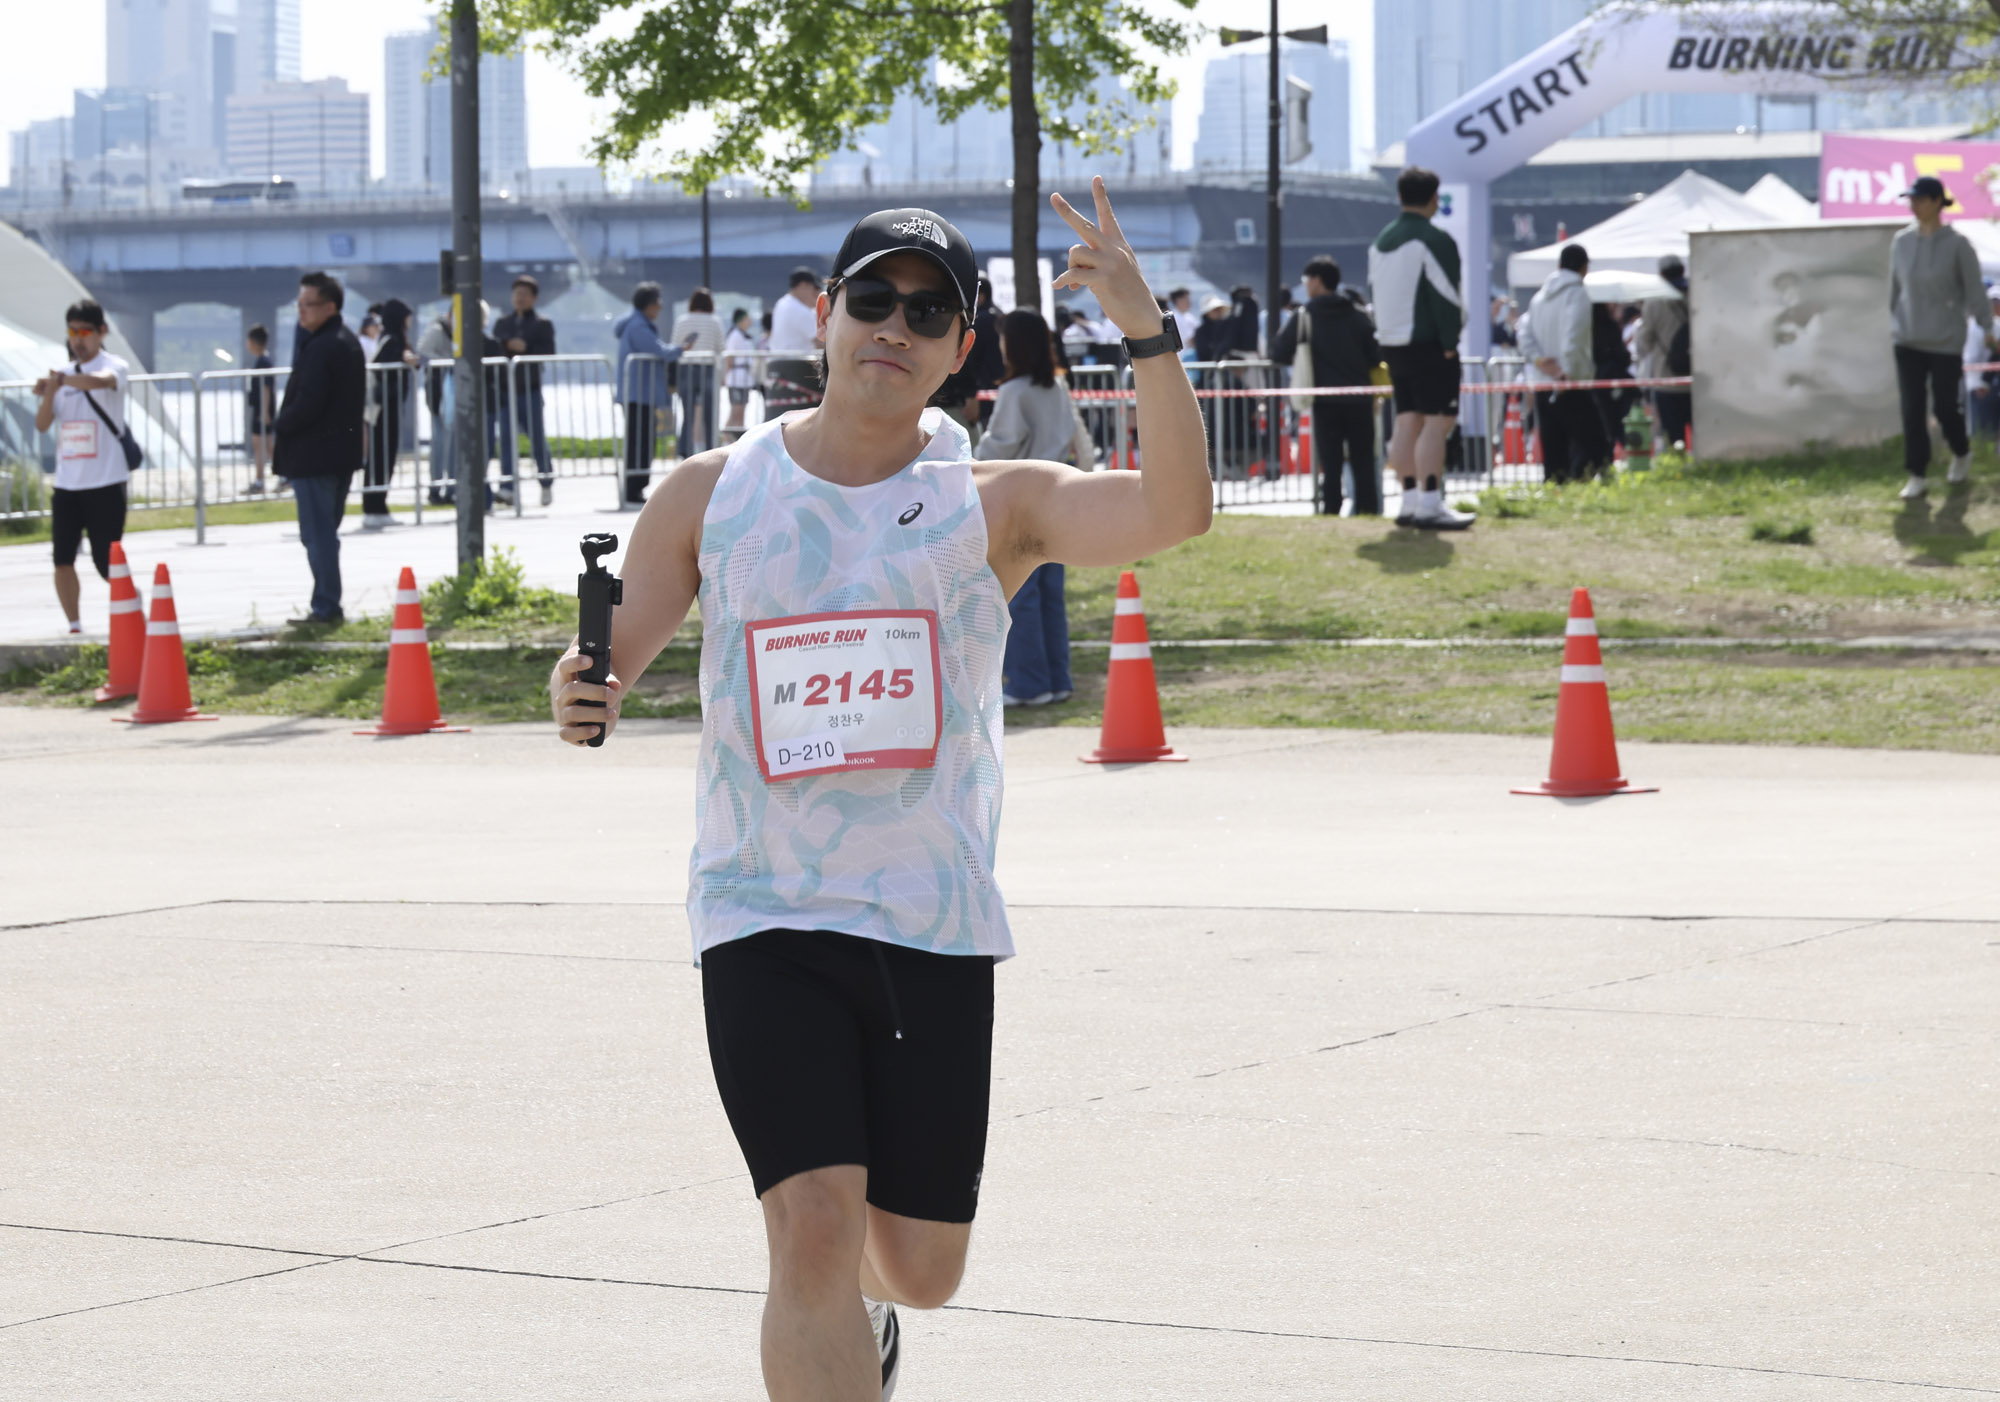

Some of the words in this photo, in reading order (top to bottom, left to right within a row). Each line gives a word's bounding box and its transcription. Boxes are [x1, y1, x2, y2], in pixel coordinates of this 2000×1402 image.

[1668, 37, 1856, 71] BURNING
[1866, 36, 1952, 71] RUN
[1454, 49, 1588, 155] START
[892, 222, 932, 233] NORTH
[910, 216, 933, 227] THE
[902, 228, 931, 239] FACE
[765, 631, 831, 652] BURNING
[834, 629, 867, 643] RUN
[885, 629, 921, 640] 10km
[773, 682, 797, 705] M
[803, 669, 915, 707] 2145
[827, 712, 865, 728] 정찬우
[778, 741, 835, 765] D-210
